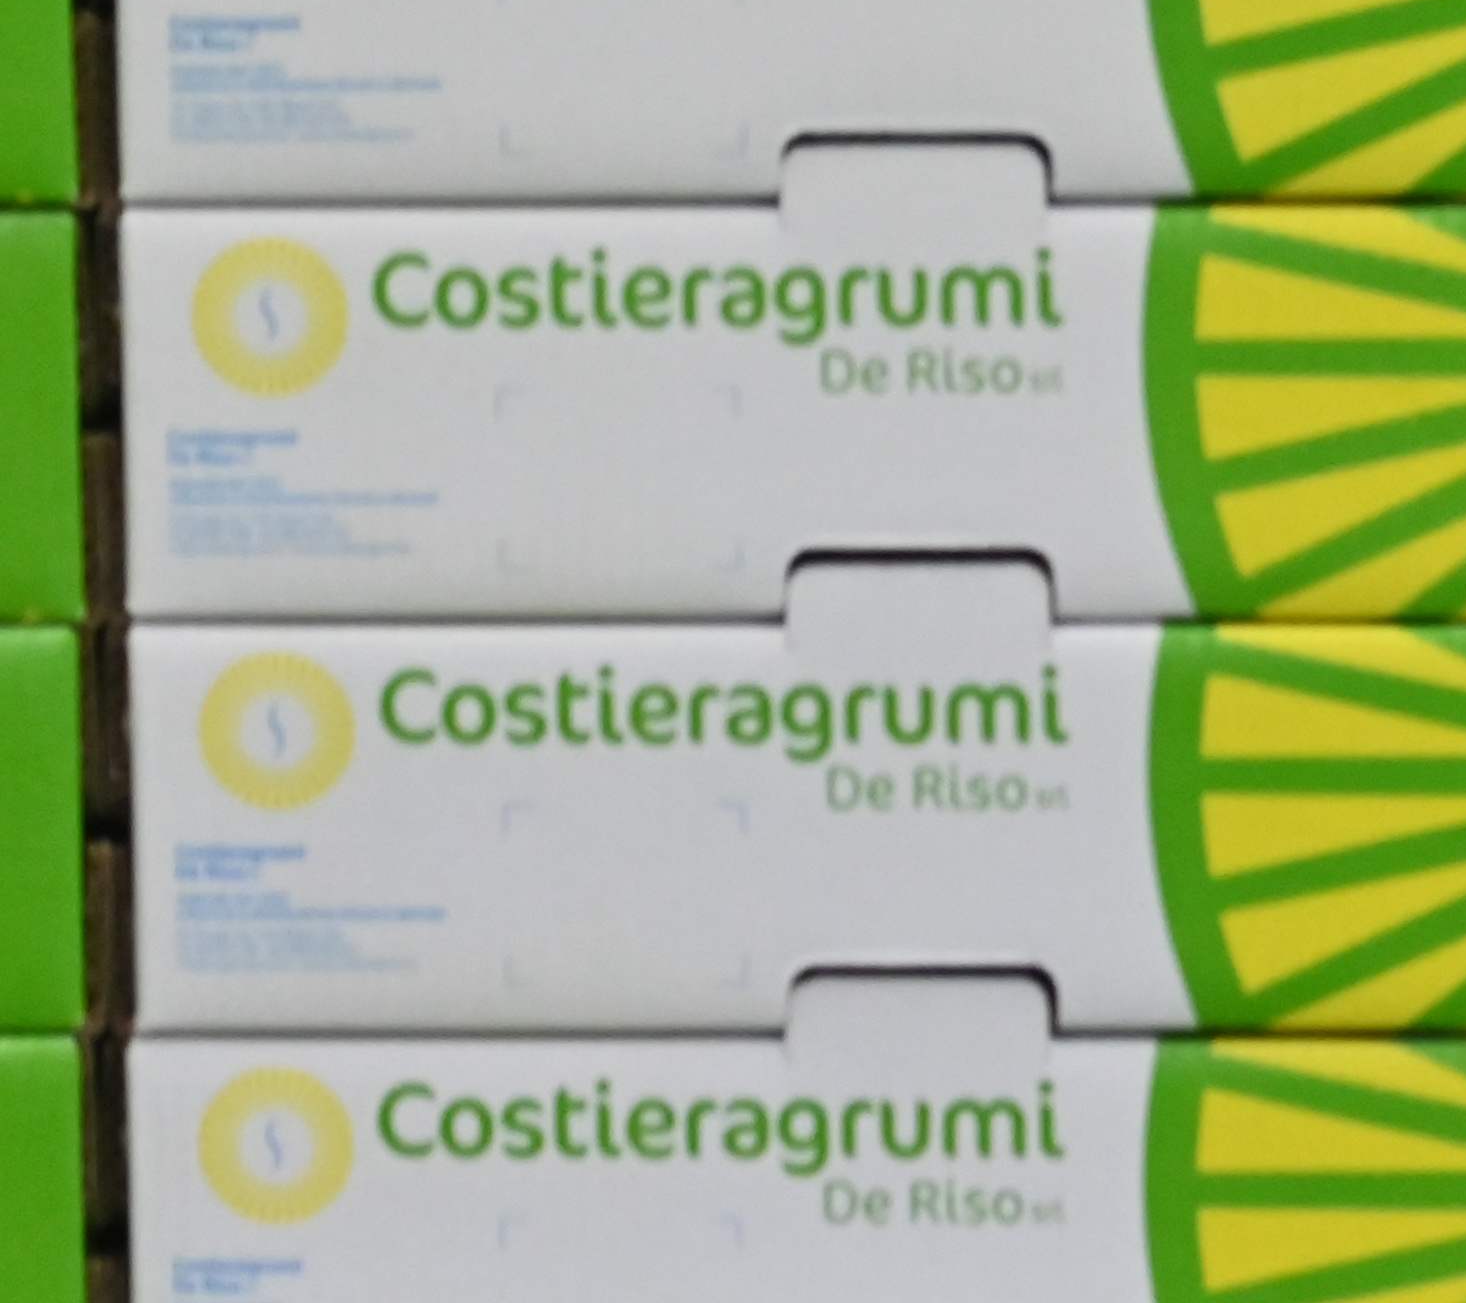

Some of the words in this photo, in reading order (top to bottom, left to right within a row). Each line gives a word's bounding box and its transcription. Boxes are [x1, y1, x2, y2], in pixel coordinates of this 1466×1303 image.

[371, 247, 1064, 347] Costieragrumi
[818, 347, 889, 396] De
[906, 346, 1023, 396] Riso
[377, 664, 1069, 763] Costieragrumi
[824, 763, 895, 812] De
[912, 762, 1029, 812] Riso
[376, 1080, 1064, 1178] Costieragrumi
[821, 1179, 892, 1228] De
[908, 1178, 1025, 1228] Riso
